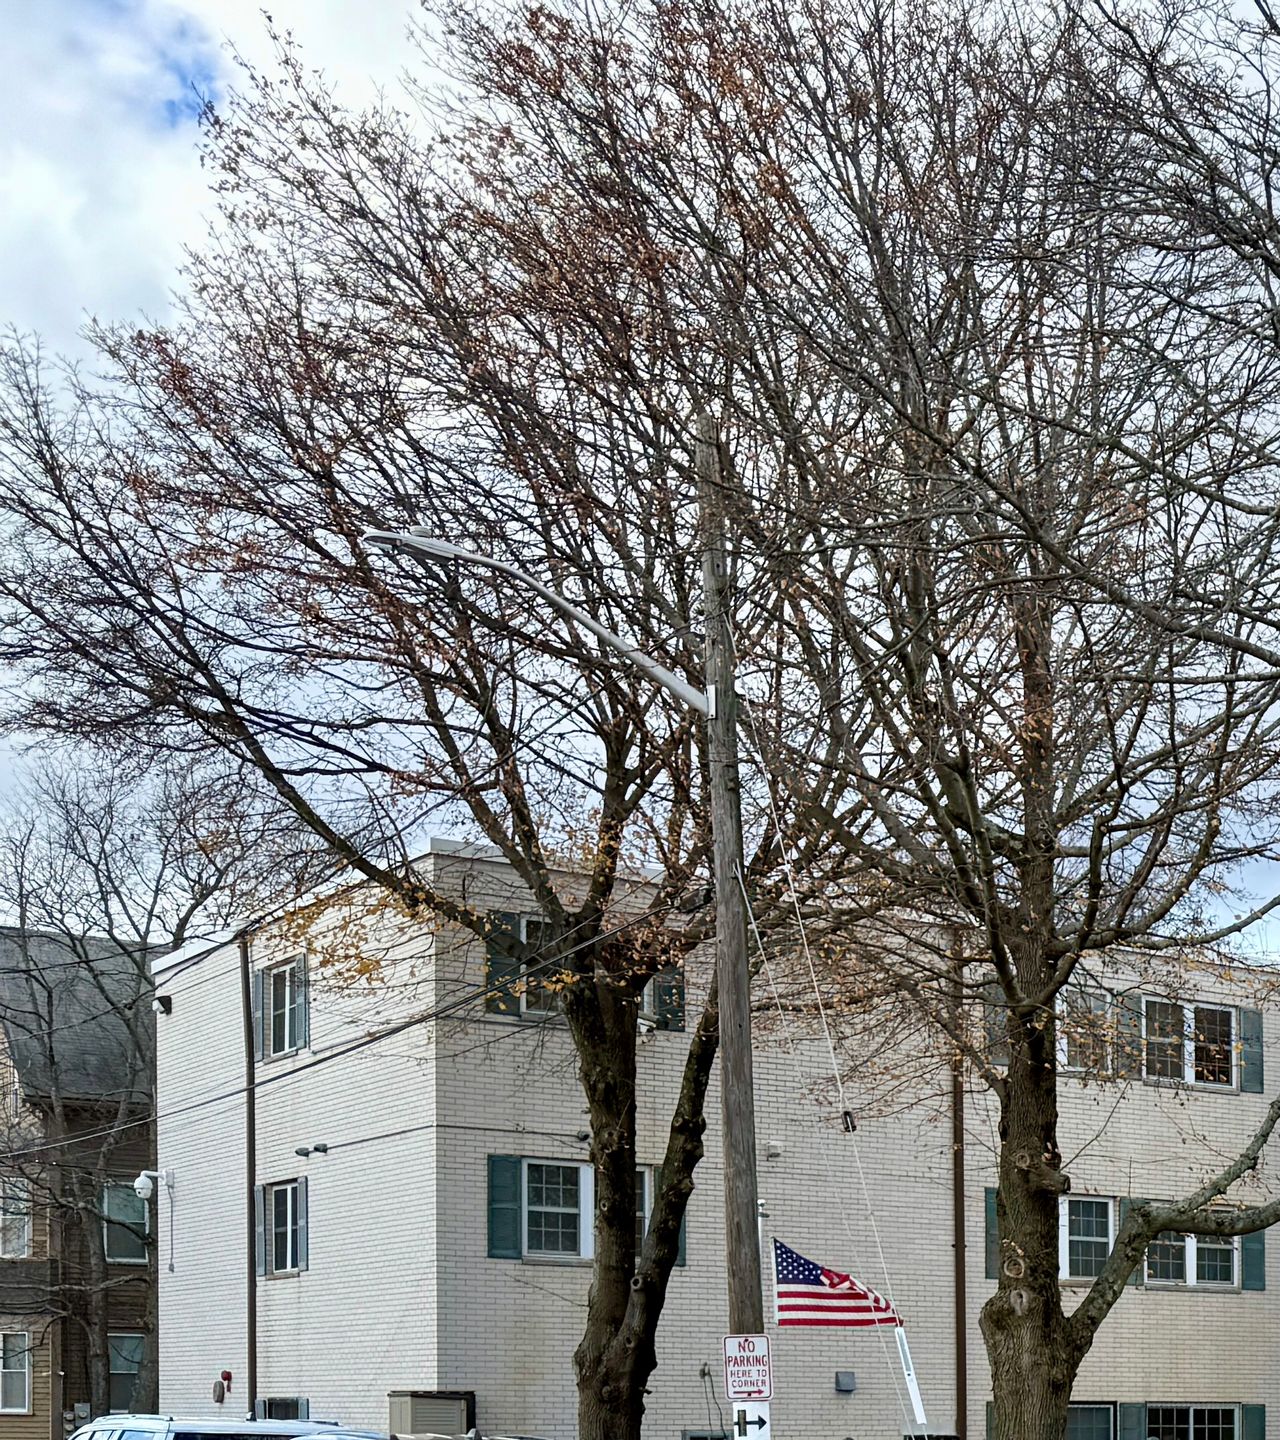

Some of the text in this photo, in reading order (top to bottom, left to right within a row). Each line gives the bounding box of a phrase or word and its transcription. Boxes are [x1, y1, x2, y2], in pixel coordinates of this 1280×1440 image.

[738, 1340, 756, 1353] NO
[727, 1355, 768, 1368] PARKING
[730, 1369, 767, 1378] HERE TO
[731, 1379, 767, 1388] CORNER
